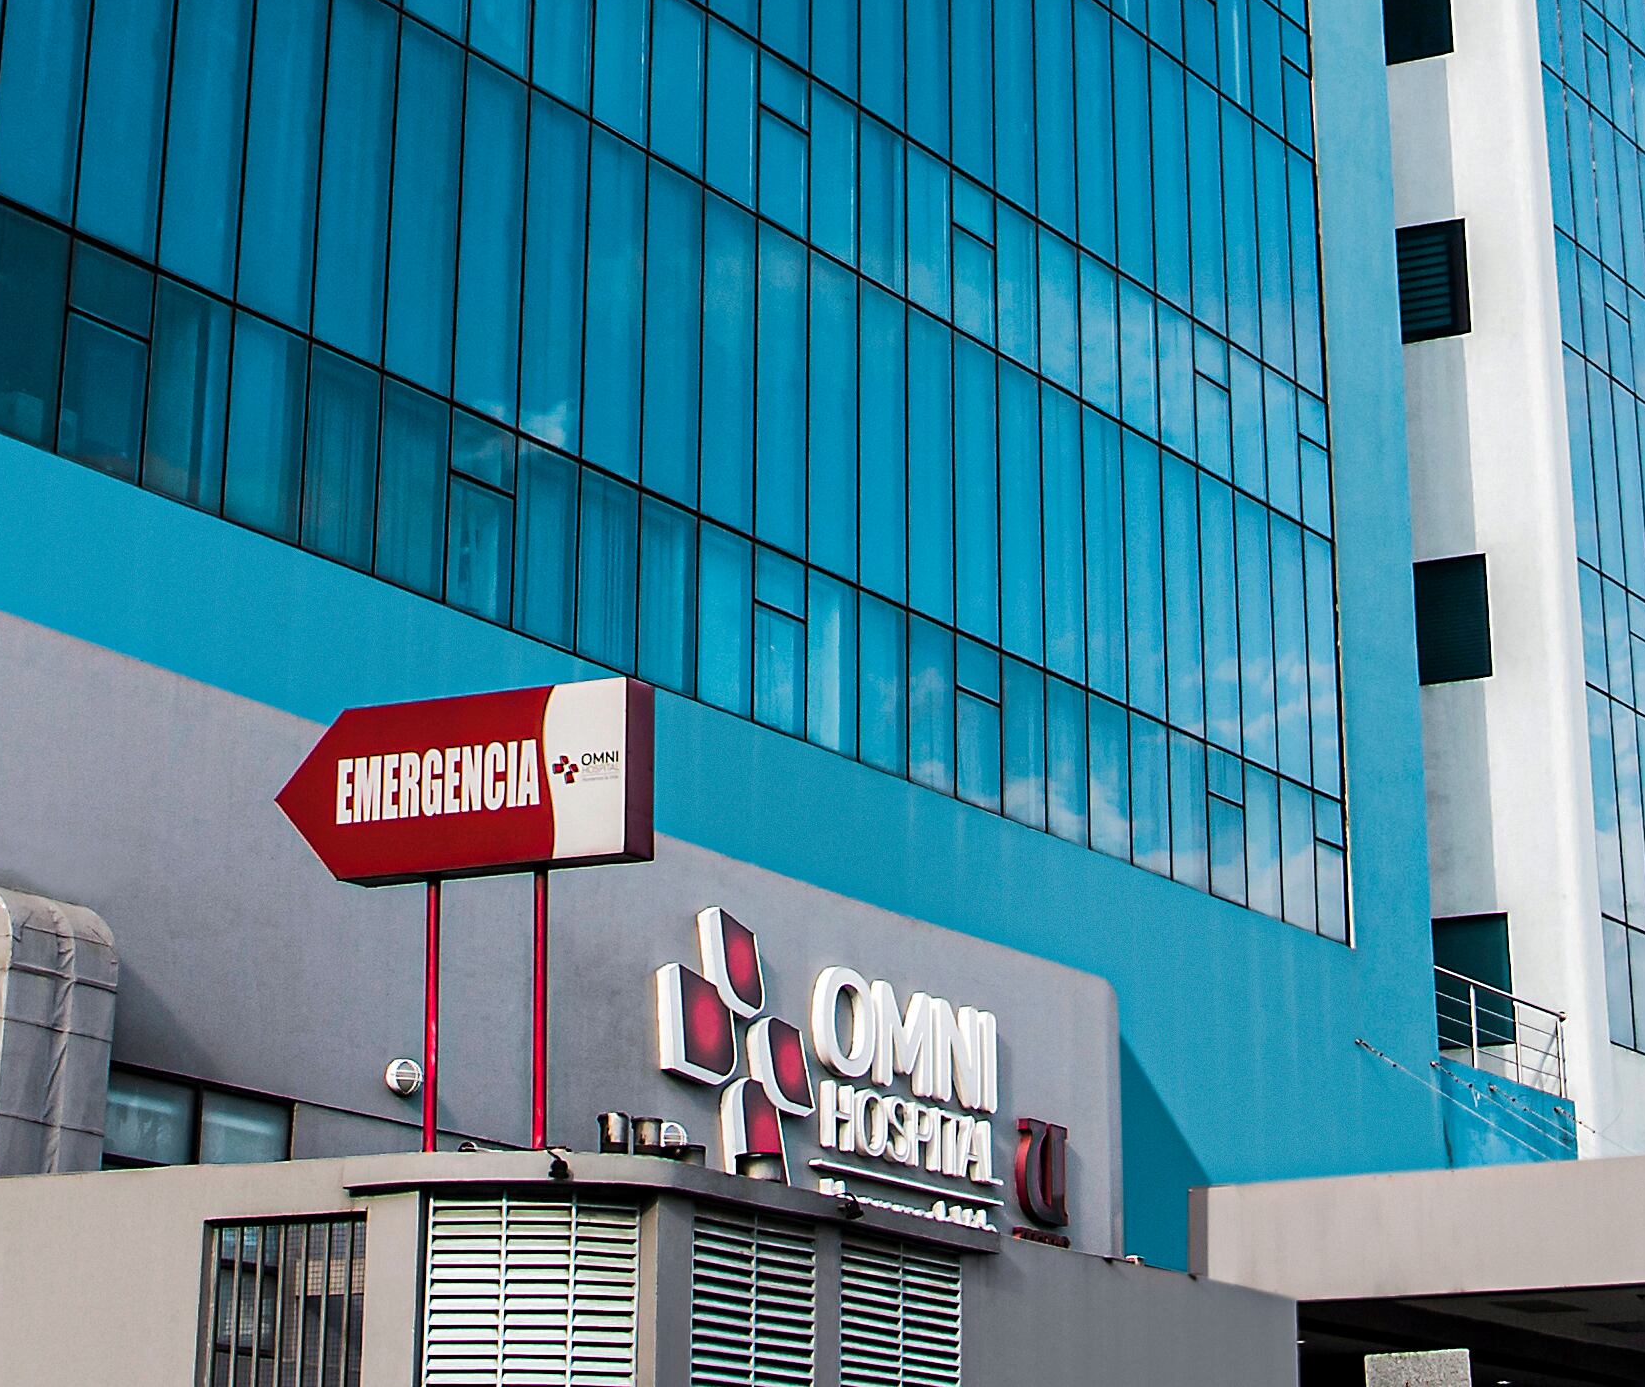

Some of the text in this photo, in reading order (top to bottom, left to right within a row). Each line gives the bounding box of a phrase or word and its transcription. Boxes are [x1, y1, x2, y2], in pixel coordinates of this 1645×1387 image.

[335, 739, 541, 825] EMERGENCIA
[581, 750, 619, 766] OMNI
[811, 965, 998, 1114] OMNI
[818, 1079, 1005, 1186] HOSPITAL
